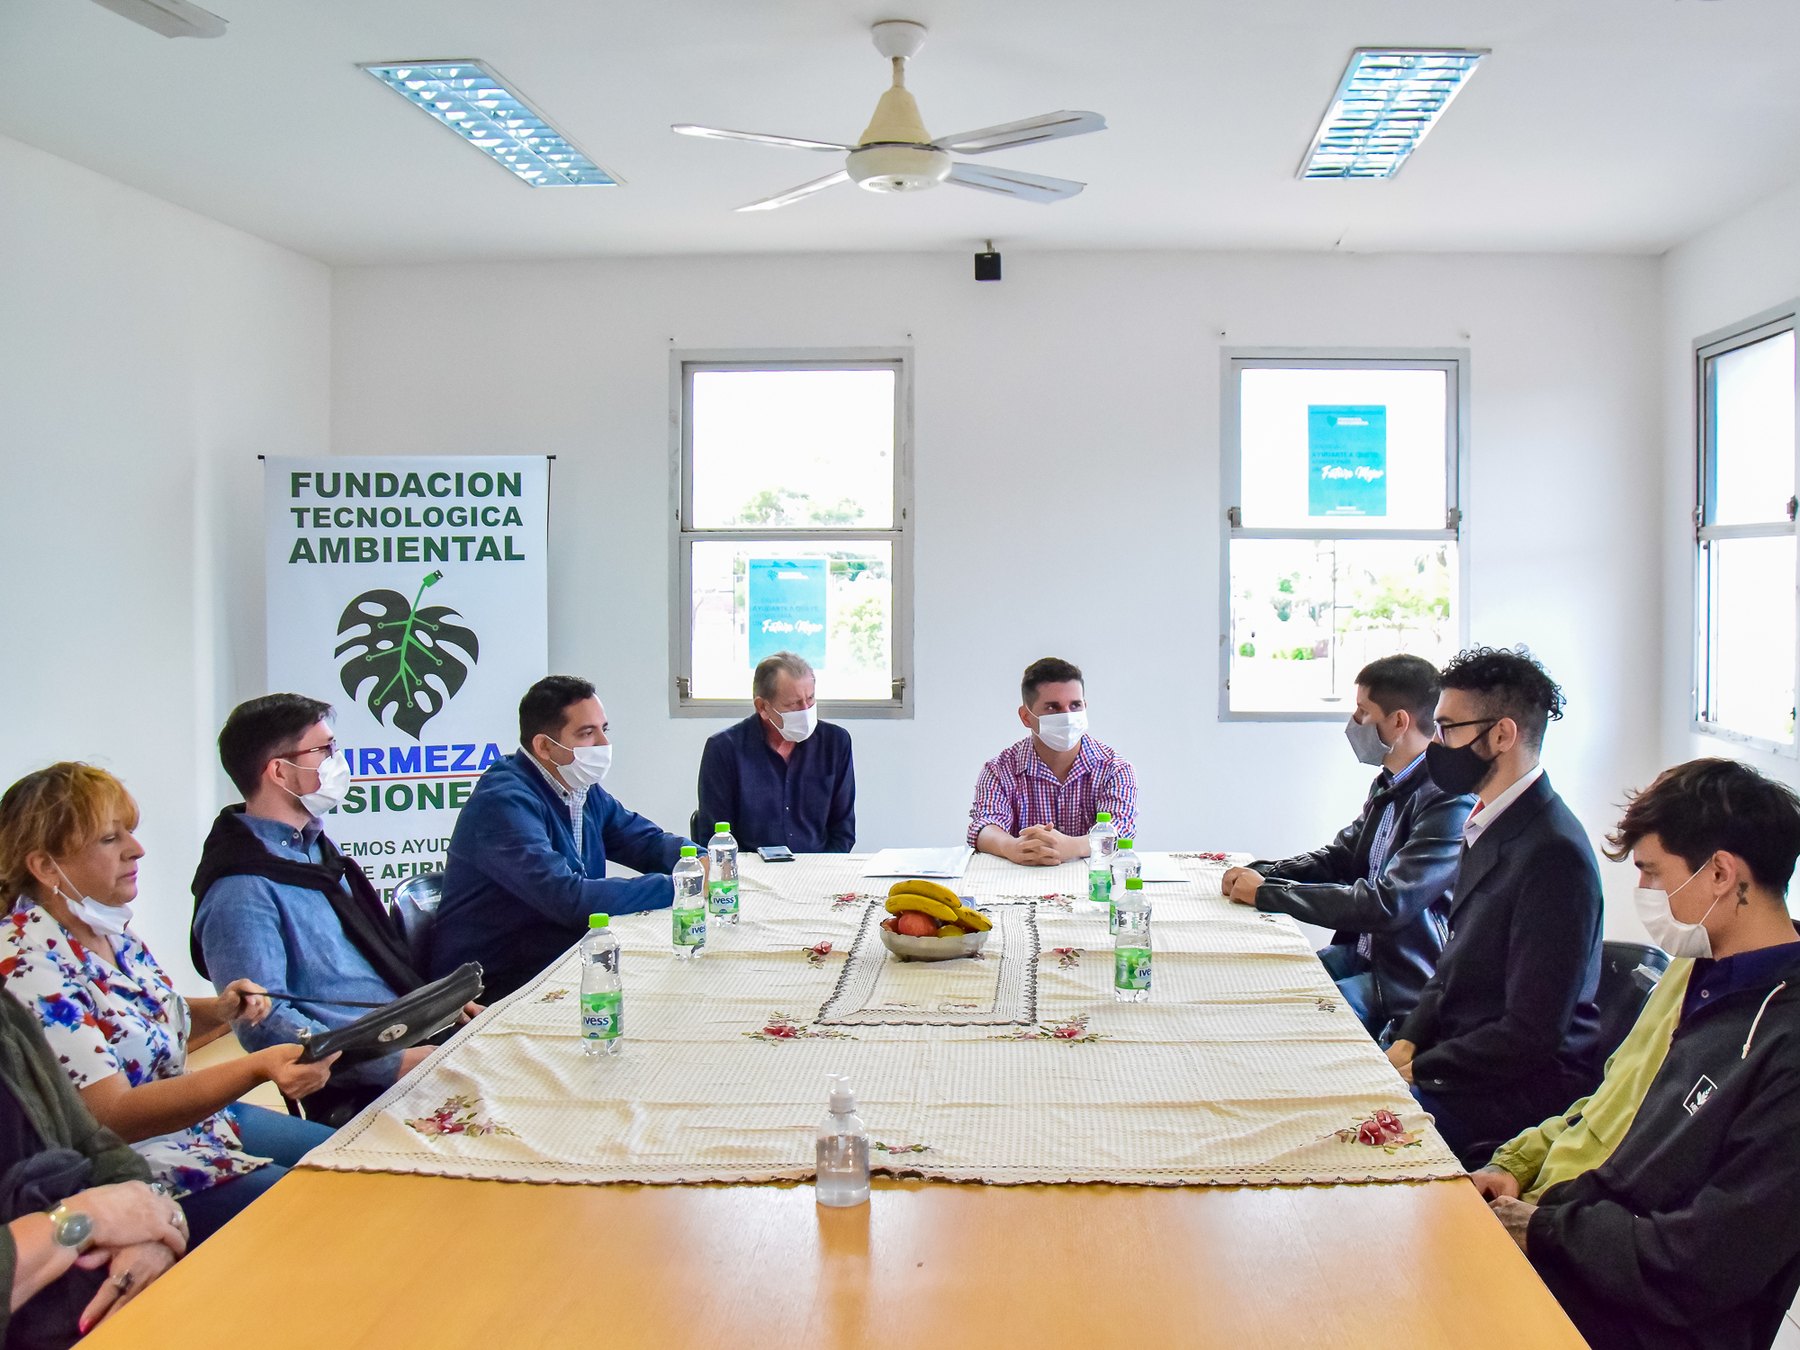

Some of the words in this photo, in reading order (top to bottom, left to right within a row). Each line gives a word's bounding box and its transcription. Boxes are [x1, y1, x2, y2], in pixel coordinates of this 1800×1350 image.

[290, 472, 522, 498] FUNDACION
[290, 506, 524, 529] TECNOLOGICA
[288, 535, 526, 564] AMBIENTAL
[344, 743, 502, 776] IRMEZA
[329, 782, 477, 814] SIONE
[341, 840, 396, 857] EMOS
[401, 838, 452, 854] AYUD
